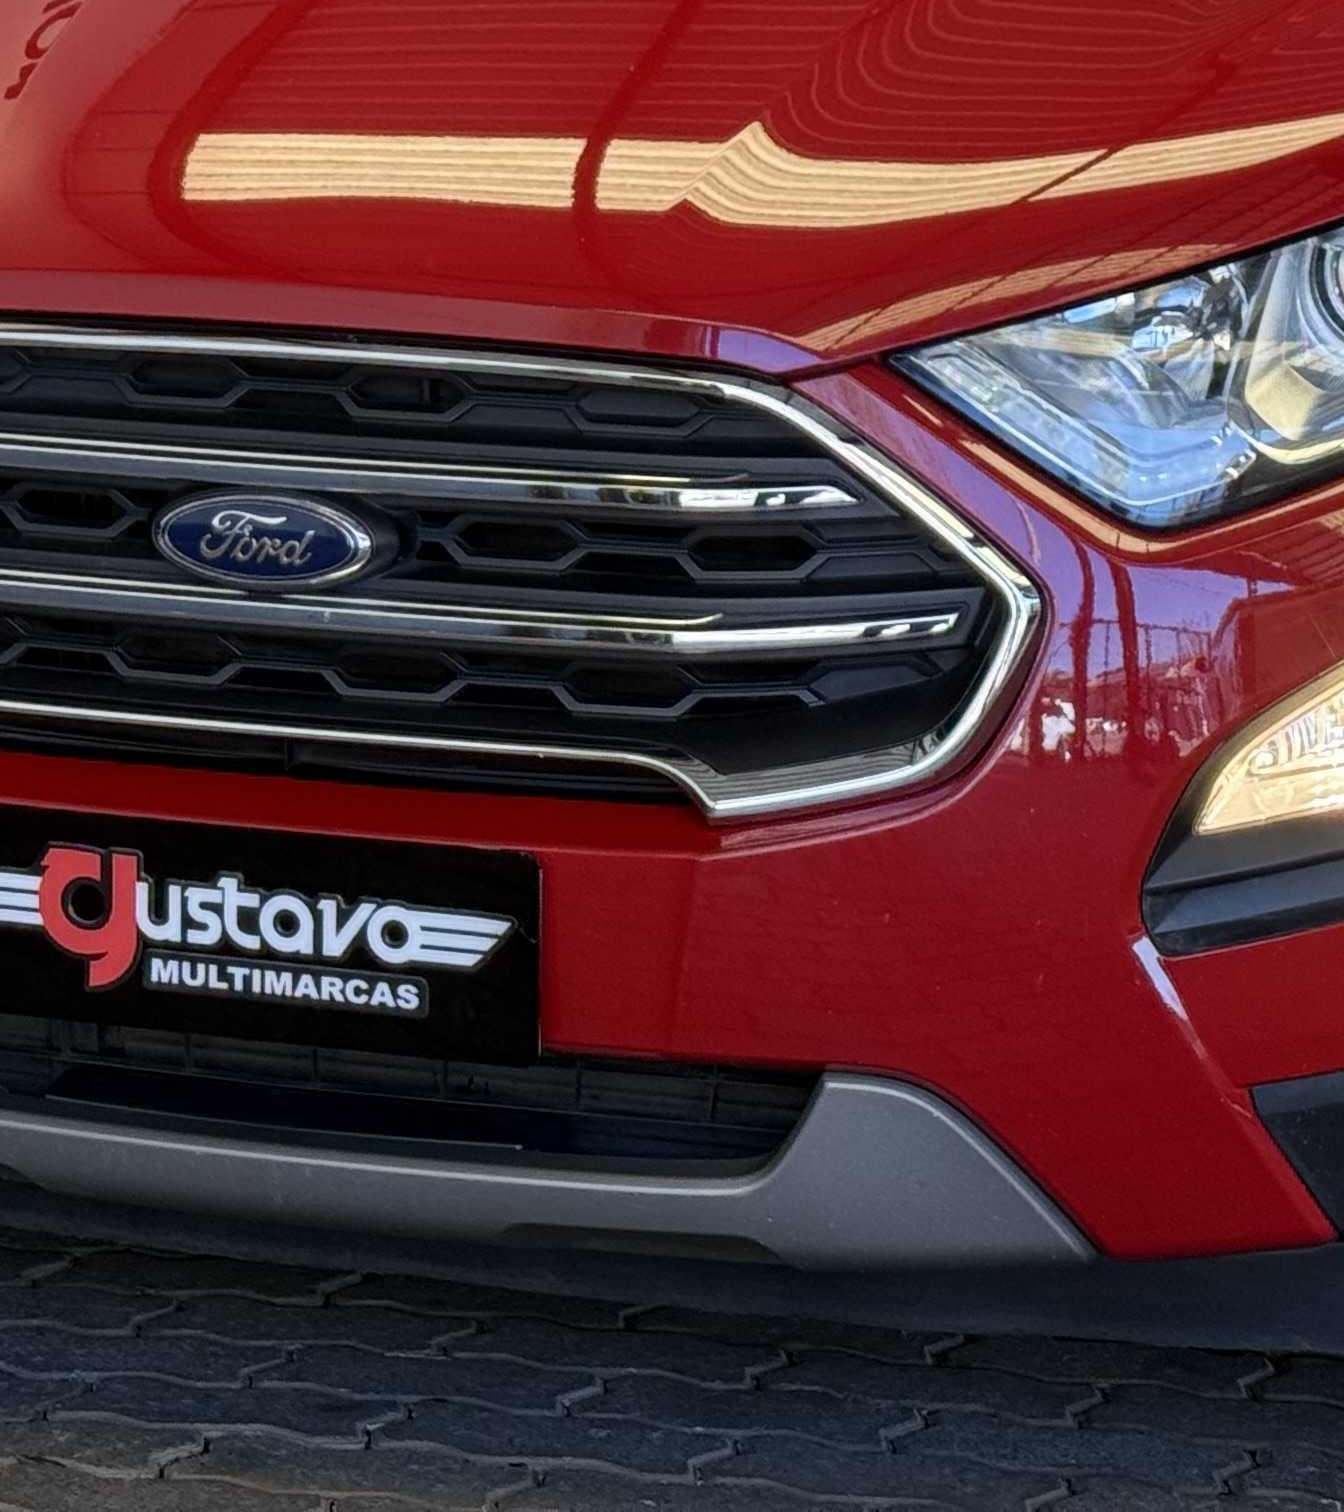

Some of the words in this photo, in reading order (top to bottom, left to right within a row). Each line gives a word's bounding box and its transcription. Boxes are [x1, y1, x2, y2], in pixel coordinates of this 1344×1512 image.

[200, 508, 314, 568] Ford
[38, 847, 424, 988] gustavo
[149, 958, 422, 1011] MULTIMARCAS
